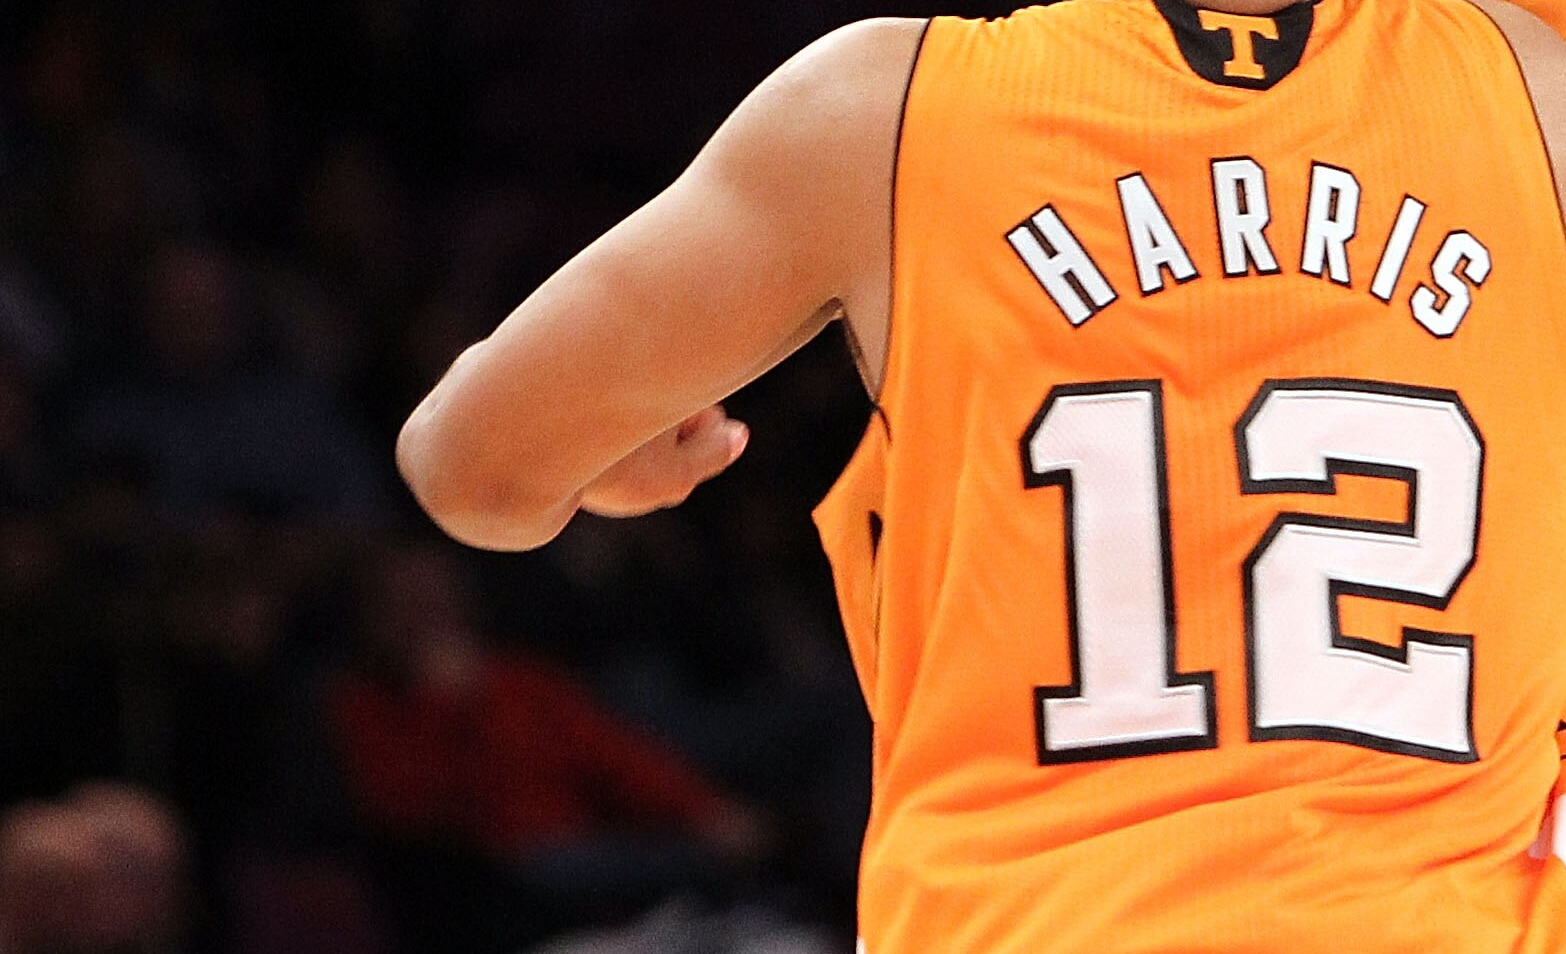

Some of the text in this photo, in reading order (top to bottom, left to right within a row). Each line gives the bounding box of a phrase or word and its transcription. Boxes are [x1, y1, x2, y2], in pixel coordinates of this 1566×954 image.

[1197, 9, 1280, 81] T
[1004, 155, 1493, 340] HARRIS
[1018, 378, 1486, 766] 12
